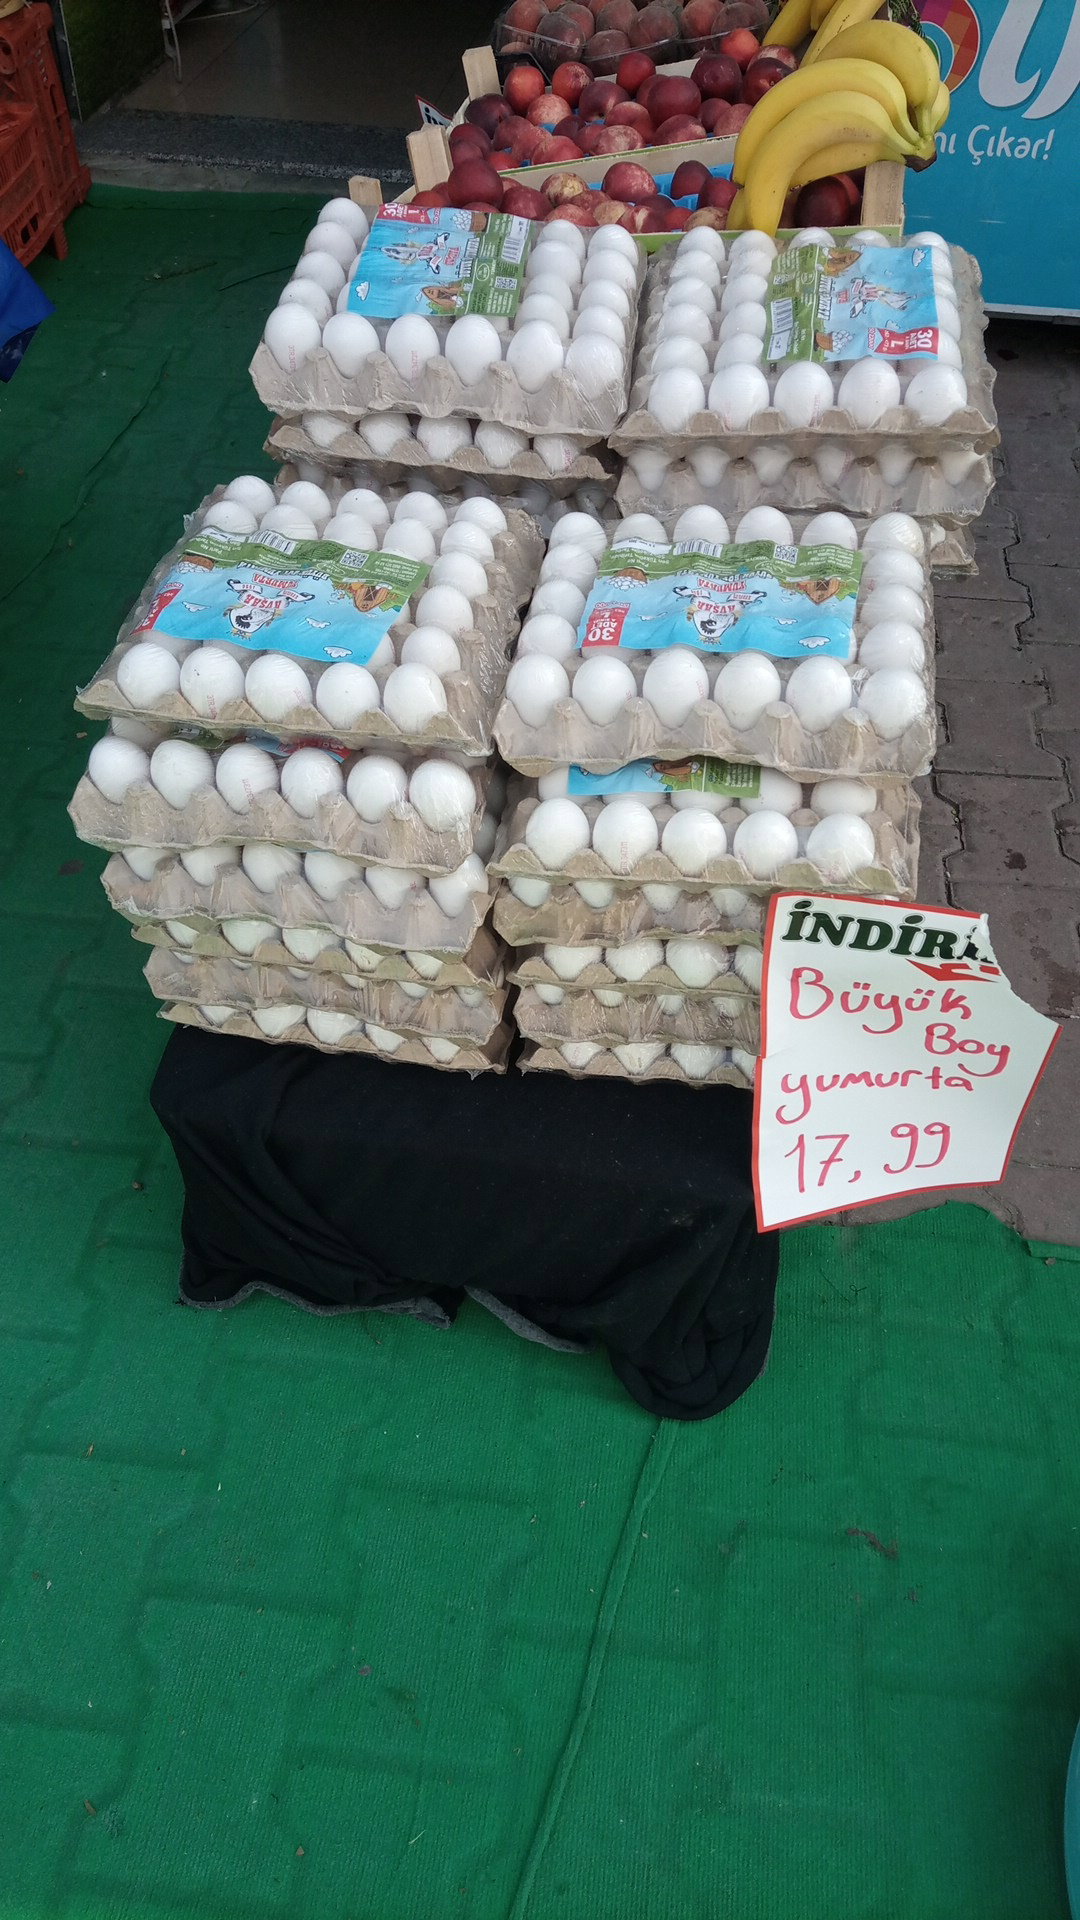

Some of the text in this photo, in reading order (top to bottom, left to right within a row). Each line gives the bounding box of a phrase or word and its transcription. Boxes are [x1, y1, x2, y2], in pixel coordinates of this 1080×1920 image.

[967, 124, 1056, 166] Çıkar!
[891, 340, 904, 348] L
[917, 329, 933, 348] 30
[588, 627, 615, 642] 30
[790, 966, 972, 1034] Büyük
[924, 1022, 1011, 1077] Boy
[775, 1066, 974, 1125] yumurta
